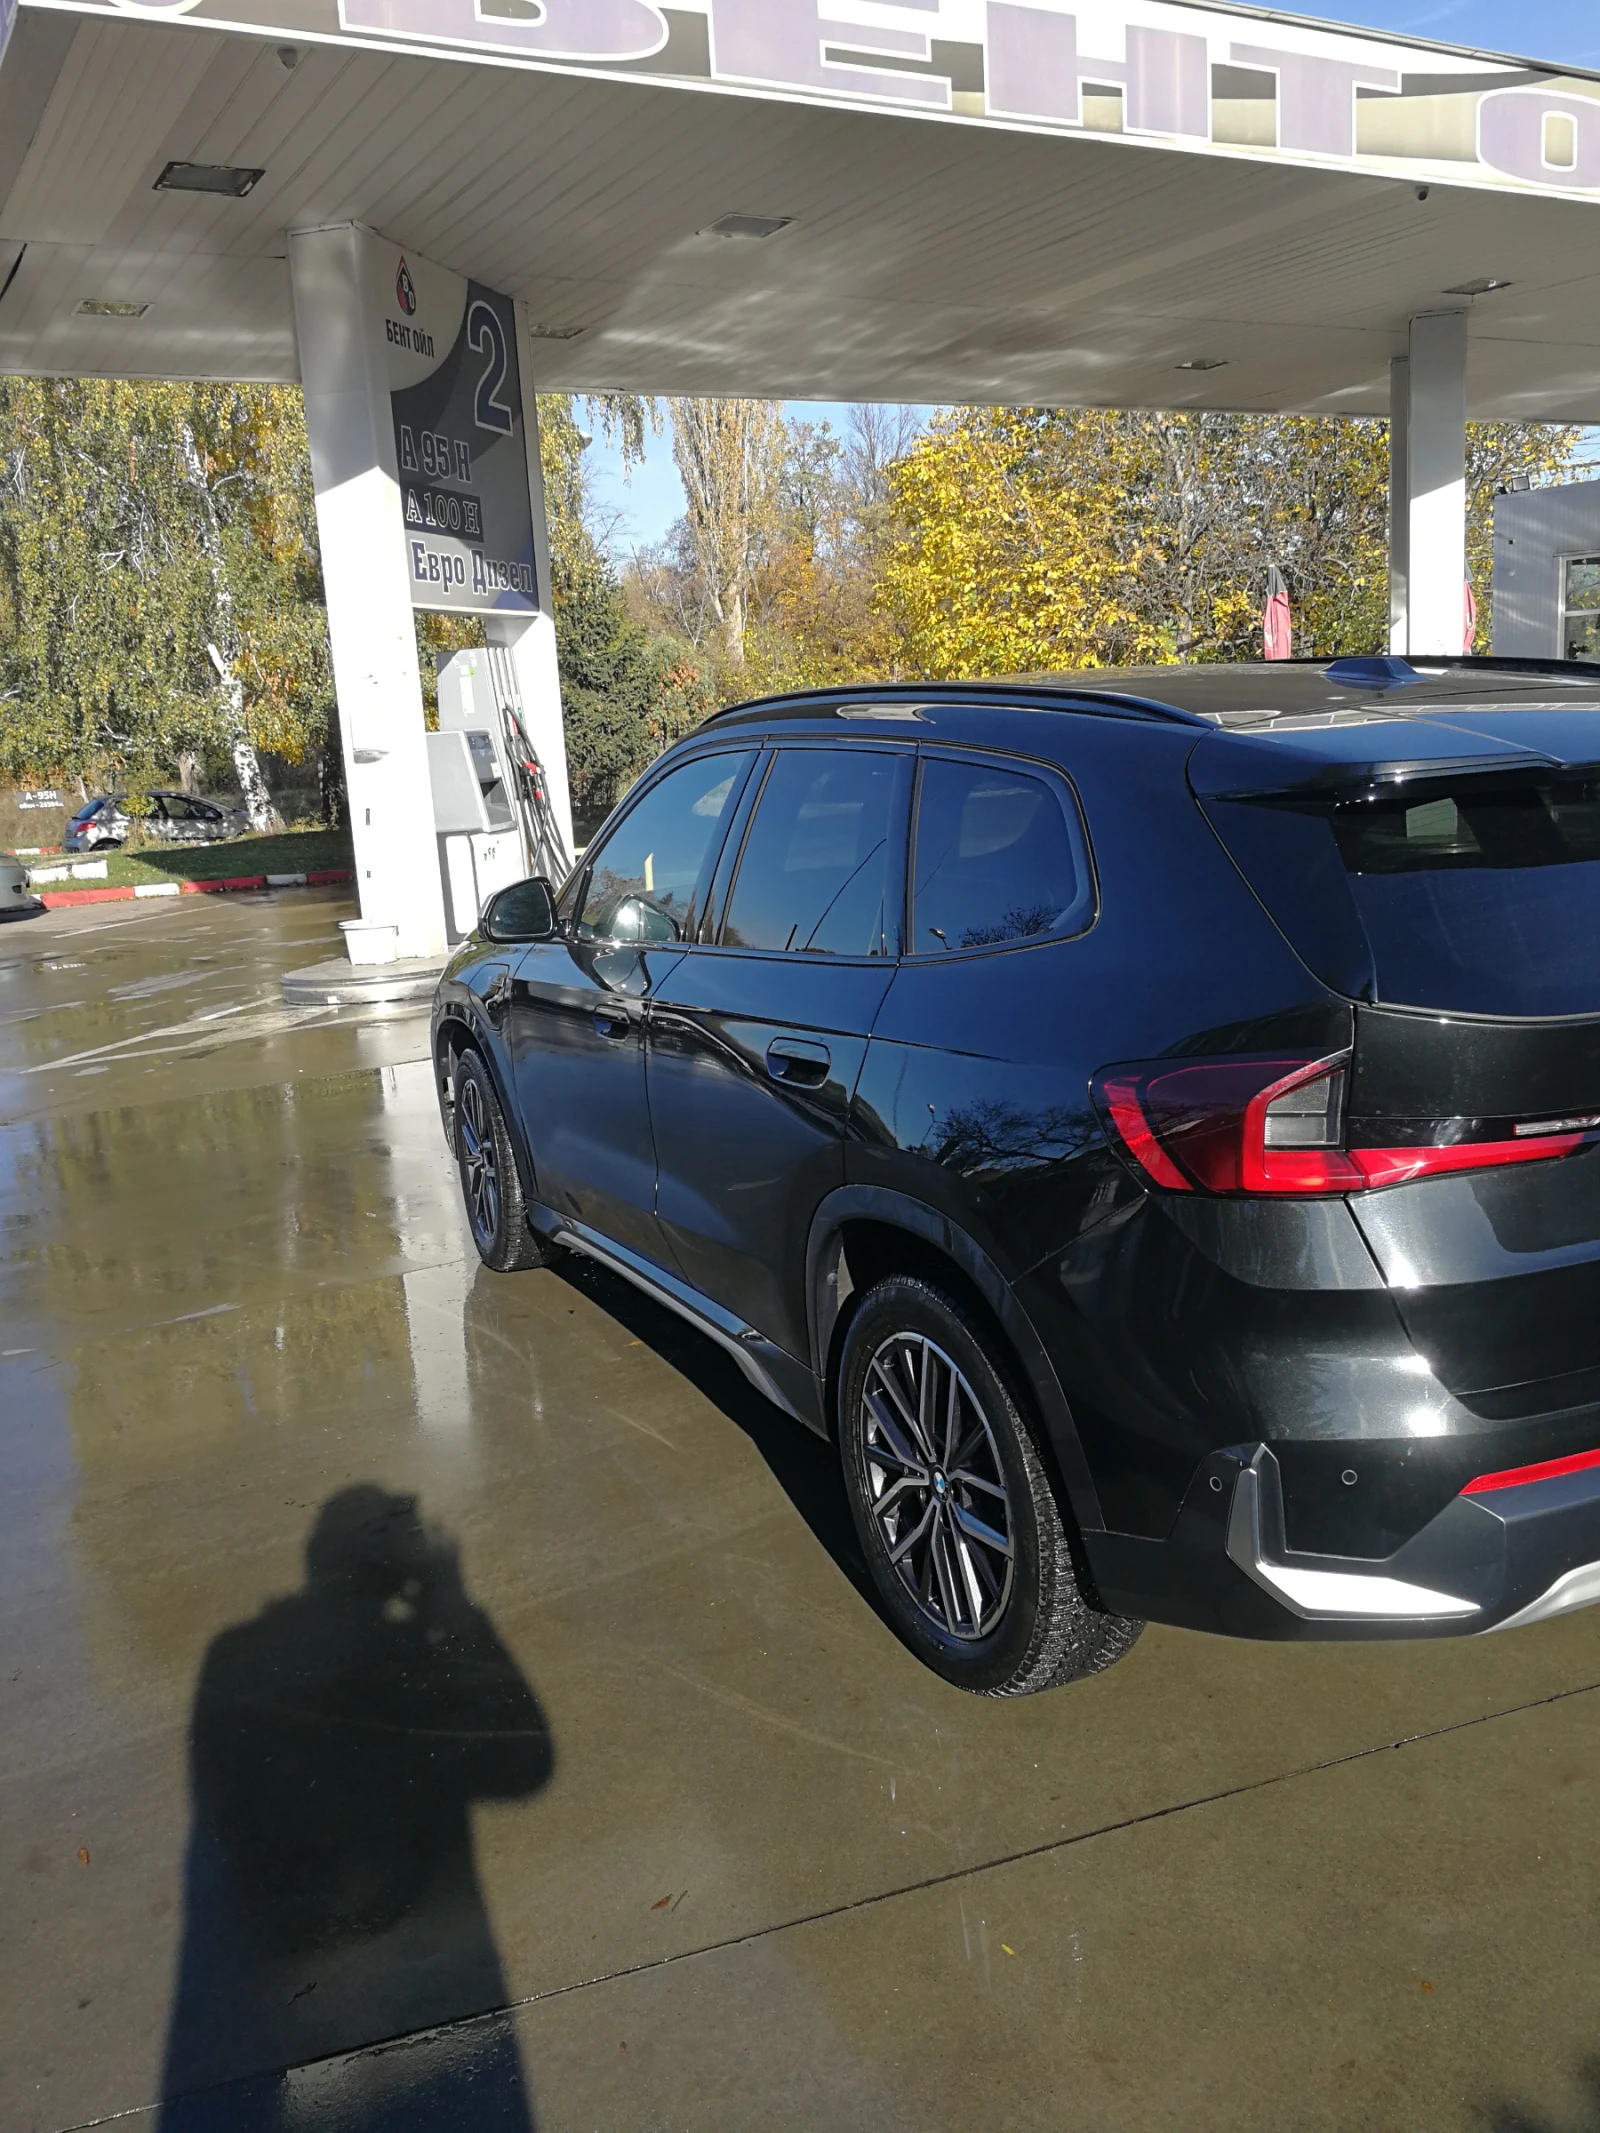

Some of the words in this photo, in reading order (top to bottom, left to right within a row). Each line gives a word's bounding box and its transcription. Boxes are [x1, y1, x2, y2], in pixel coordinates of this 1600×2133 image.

[386, 318, 411, 350] БЕНТ
[413, 327, 435, 359] ОЙЛ
[467, 300, 513, 437] 2
[400, 424, 419, 472] А
[421, 430, 450, 479] 95
[454, 439, 473, 484] Н
[406, 488, 423, 524] А
[423, 492, 461, 531] 100
[463, 501, 480, 534] Н
[410, 539, 466, 595] Евро
[469, 548, 533, 597] Дизел
